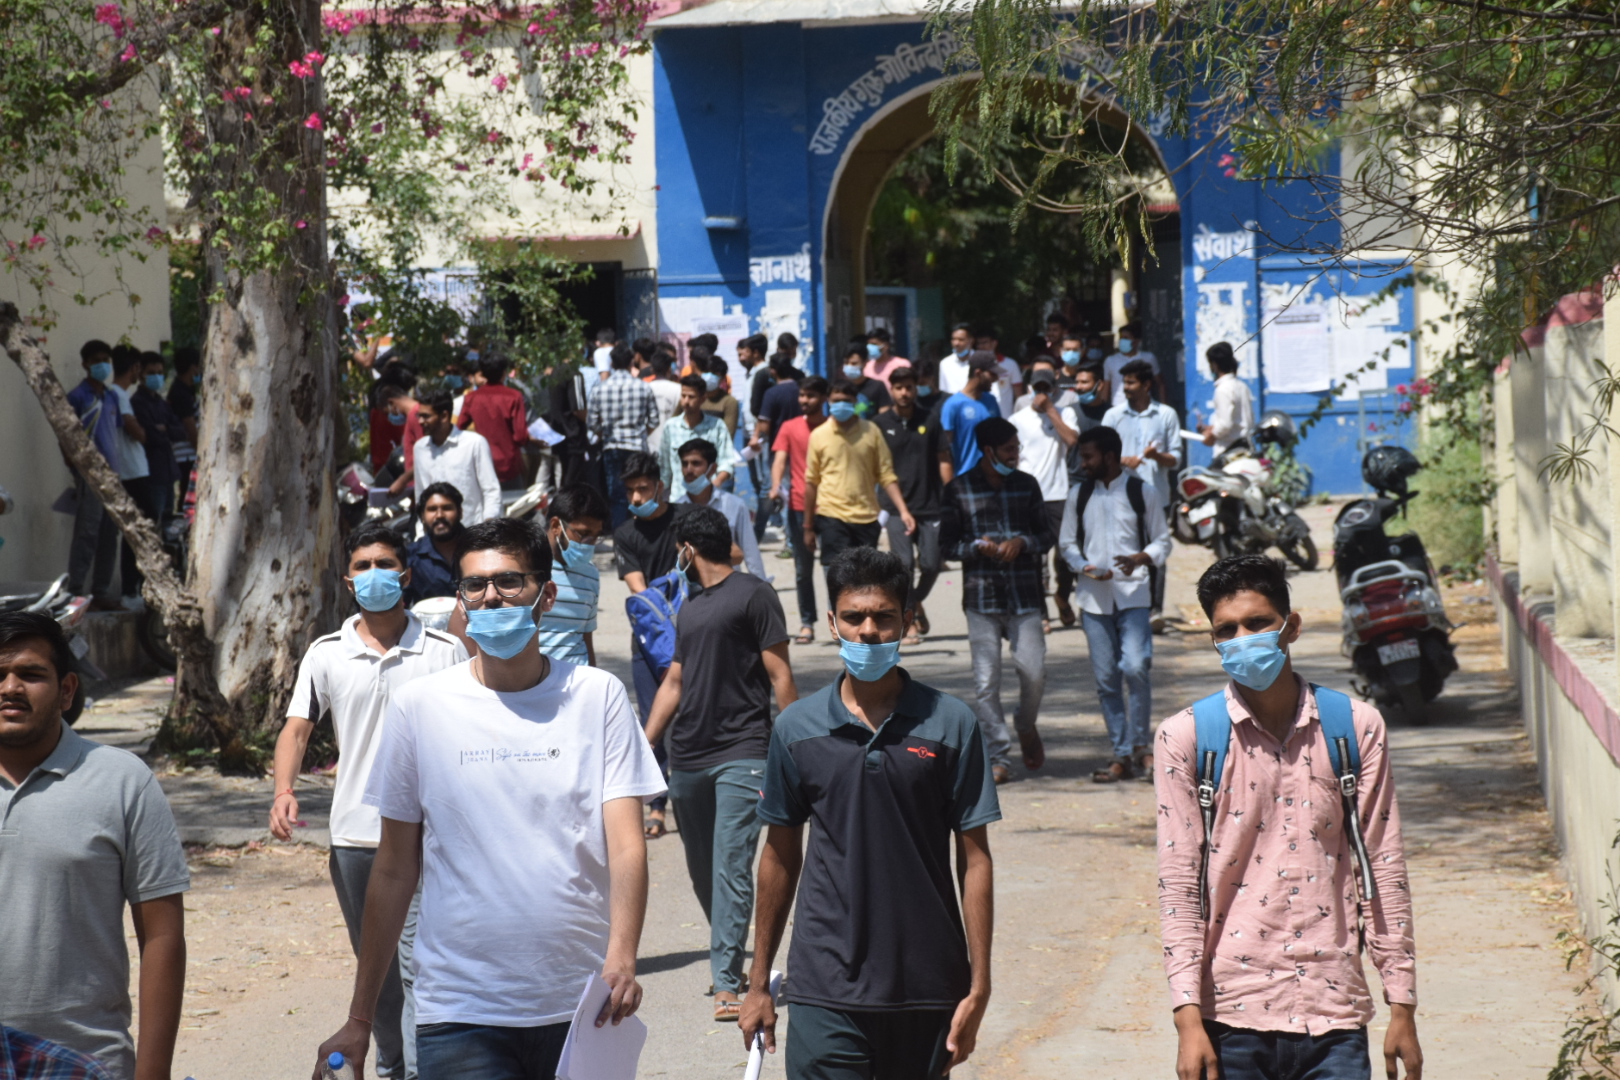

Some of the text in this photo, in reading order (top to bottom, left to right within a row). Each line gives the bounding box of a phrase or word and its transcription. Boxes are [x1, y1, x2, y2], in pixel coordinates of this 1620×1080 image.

[809, 97, 863, 154] राजकीय
[1193, 220, 1255, 262] सेवार्थ
[749, 242, 812, 287] ज्ञानार्थ
